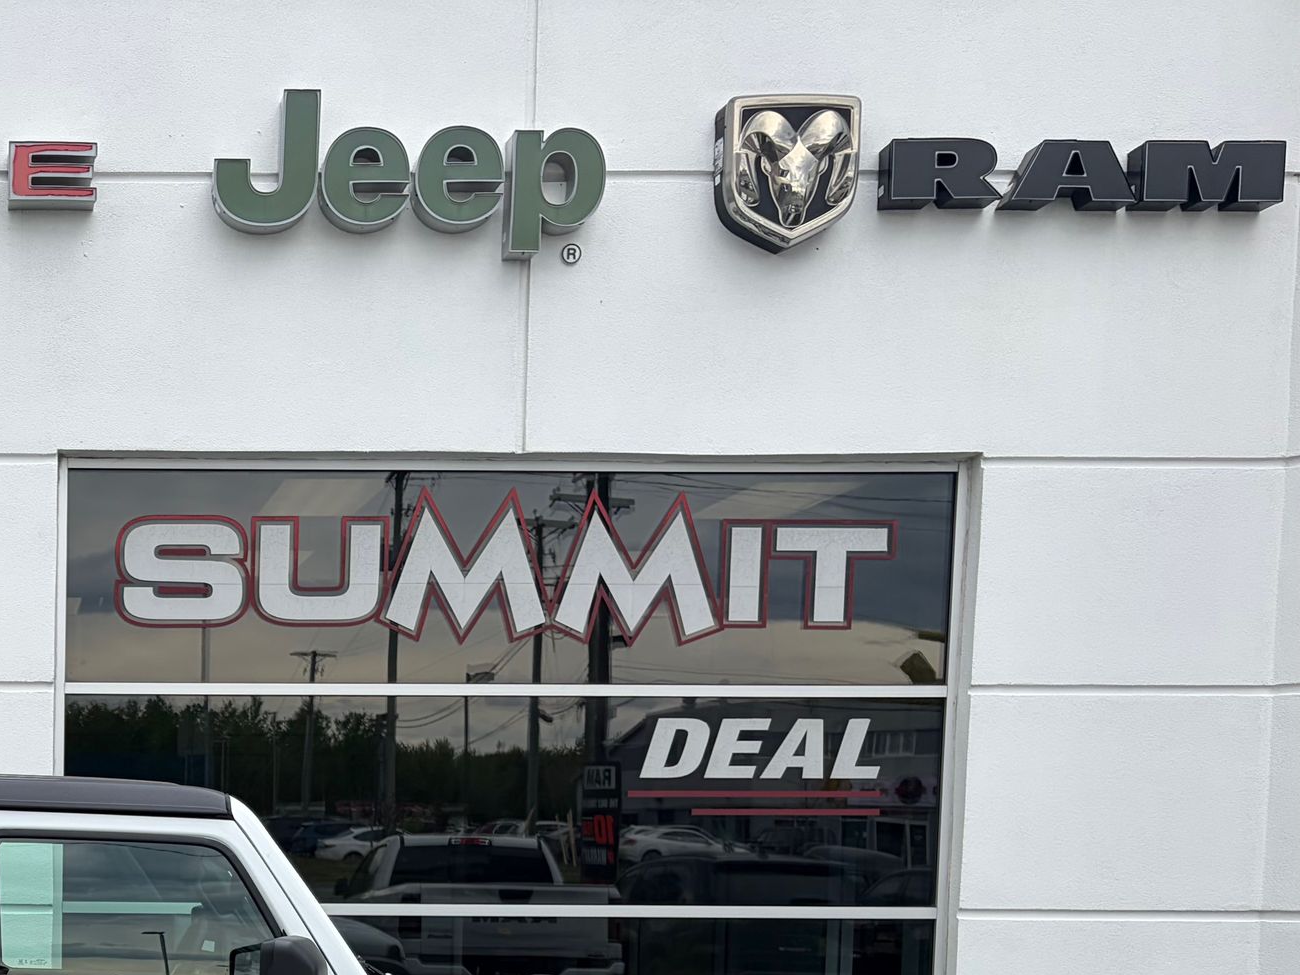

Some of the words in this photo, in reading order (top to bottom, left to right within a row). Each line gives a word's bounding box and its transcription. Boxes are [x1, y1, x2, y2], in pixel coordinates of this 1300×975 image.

[213, 89, 606, 258] Jeep
[877, 137, 1286, 210] RAM
[115, 487, 897, 645] SUMMIT
[639, 717, 881, 780] DEAL
